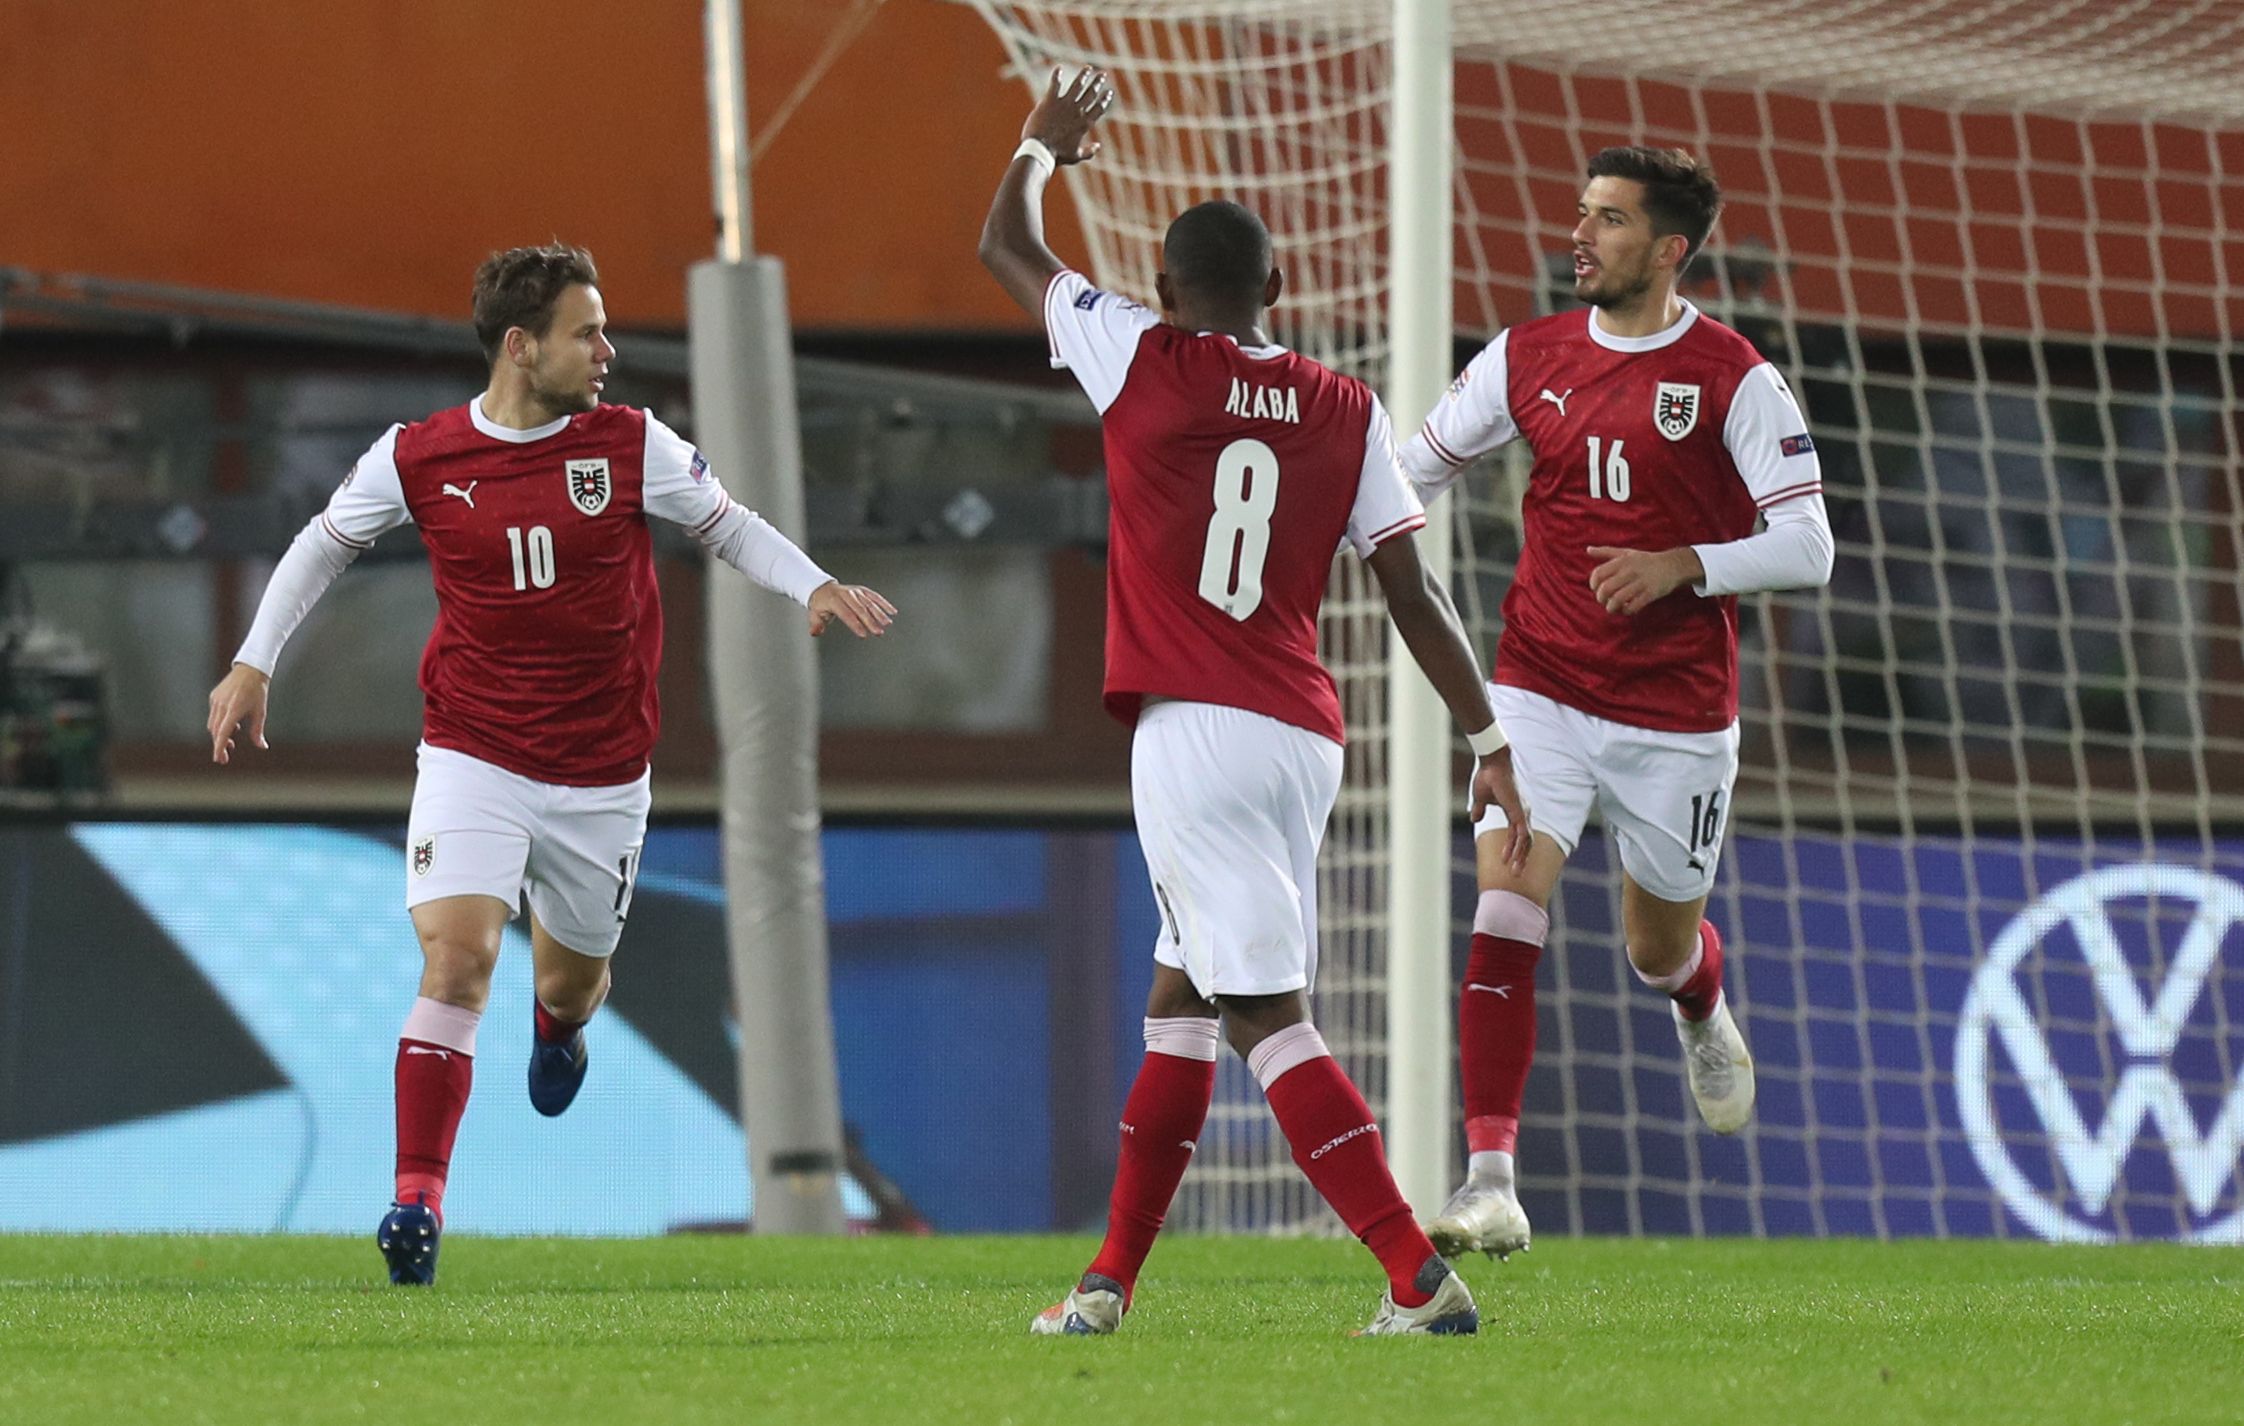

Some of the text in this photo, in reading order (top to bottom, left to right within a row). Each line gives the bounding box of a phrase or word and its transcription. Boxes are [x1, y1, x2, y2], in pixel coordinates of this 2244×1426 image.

[1225, 376, 1300, 424] ALABA
[1586, 435, 1631, 502] 16
[506, 525, 556, 591] 10
[1198, 438, 1280, 622] 8
[1690, 790, 1719, 853] 16
[1155, 881, 1181, 947] 8
[1965, 878, 2244, 1222] VW
